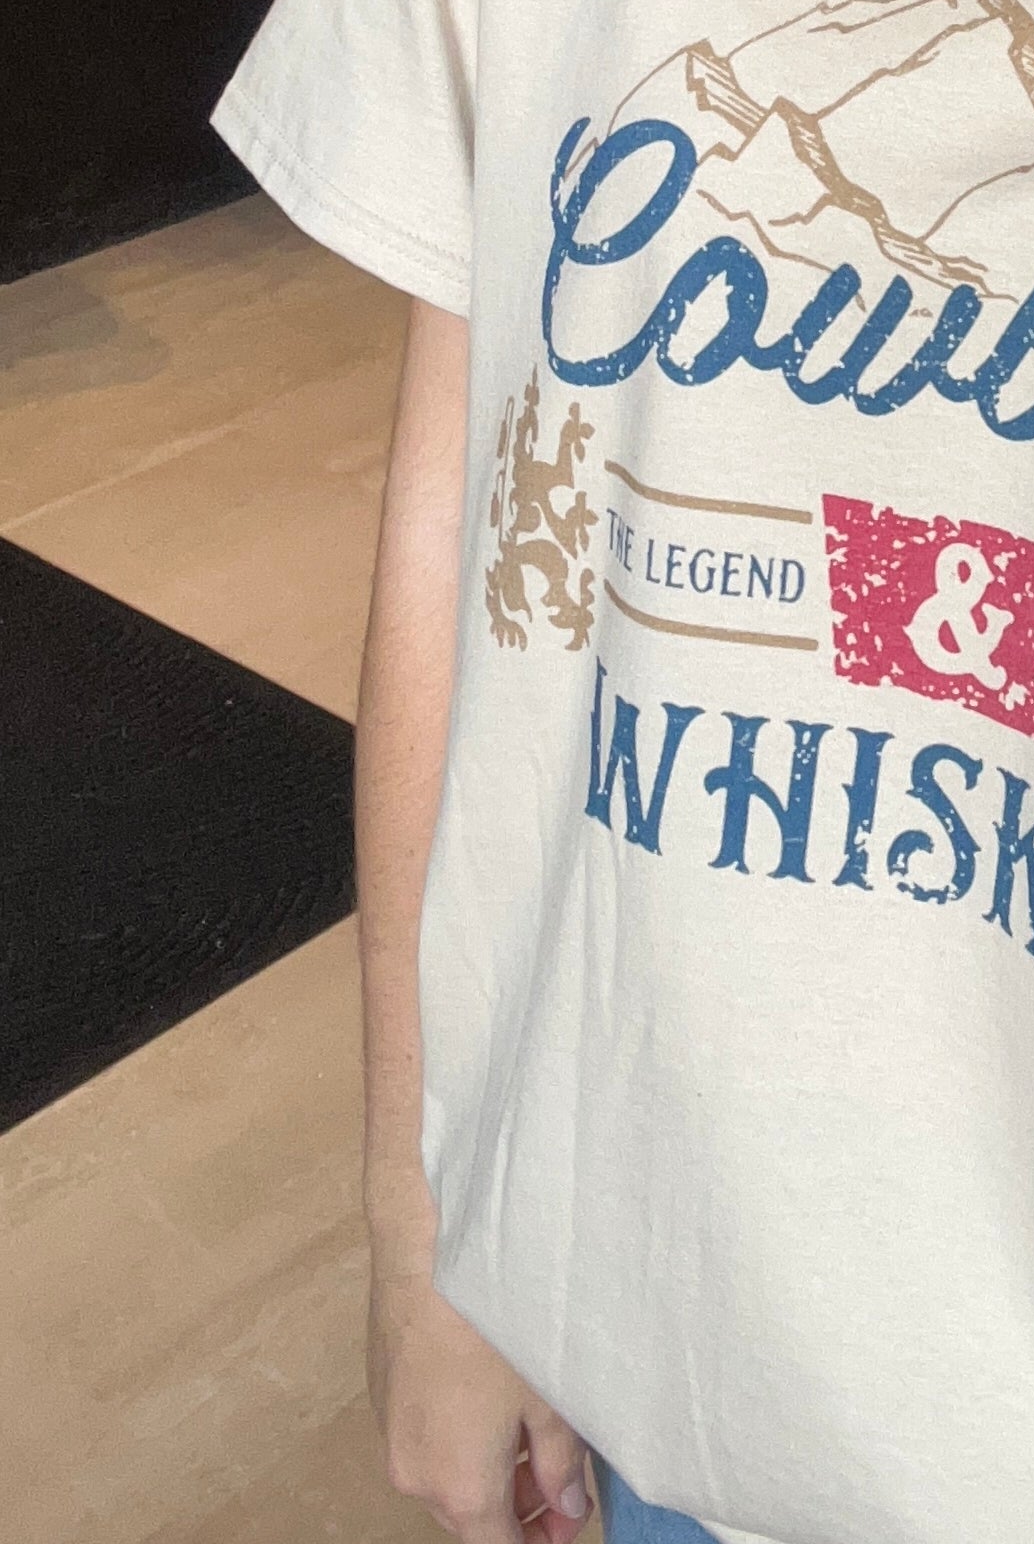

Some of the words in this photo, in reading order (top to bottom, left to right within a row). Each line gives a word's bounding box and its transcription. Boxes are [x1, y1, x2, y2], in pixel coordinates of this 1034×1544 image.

[606, 507, 635, 573] THE
[645, 538, 806, 604] LEGEND
[903, 540, 1015, 692] &
